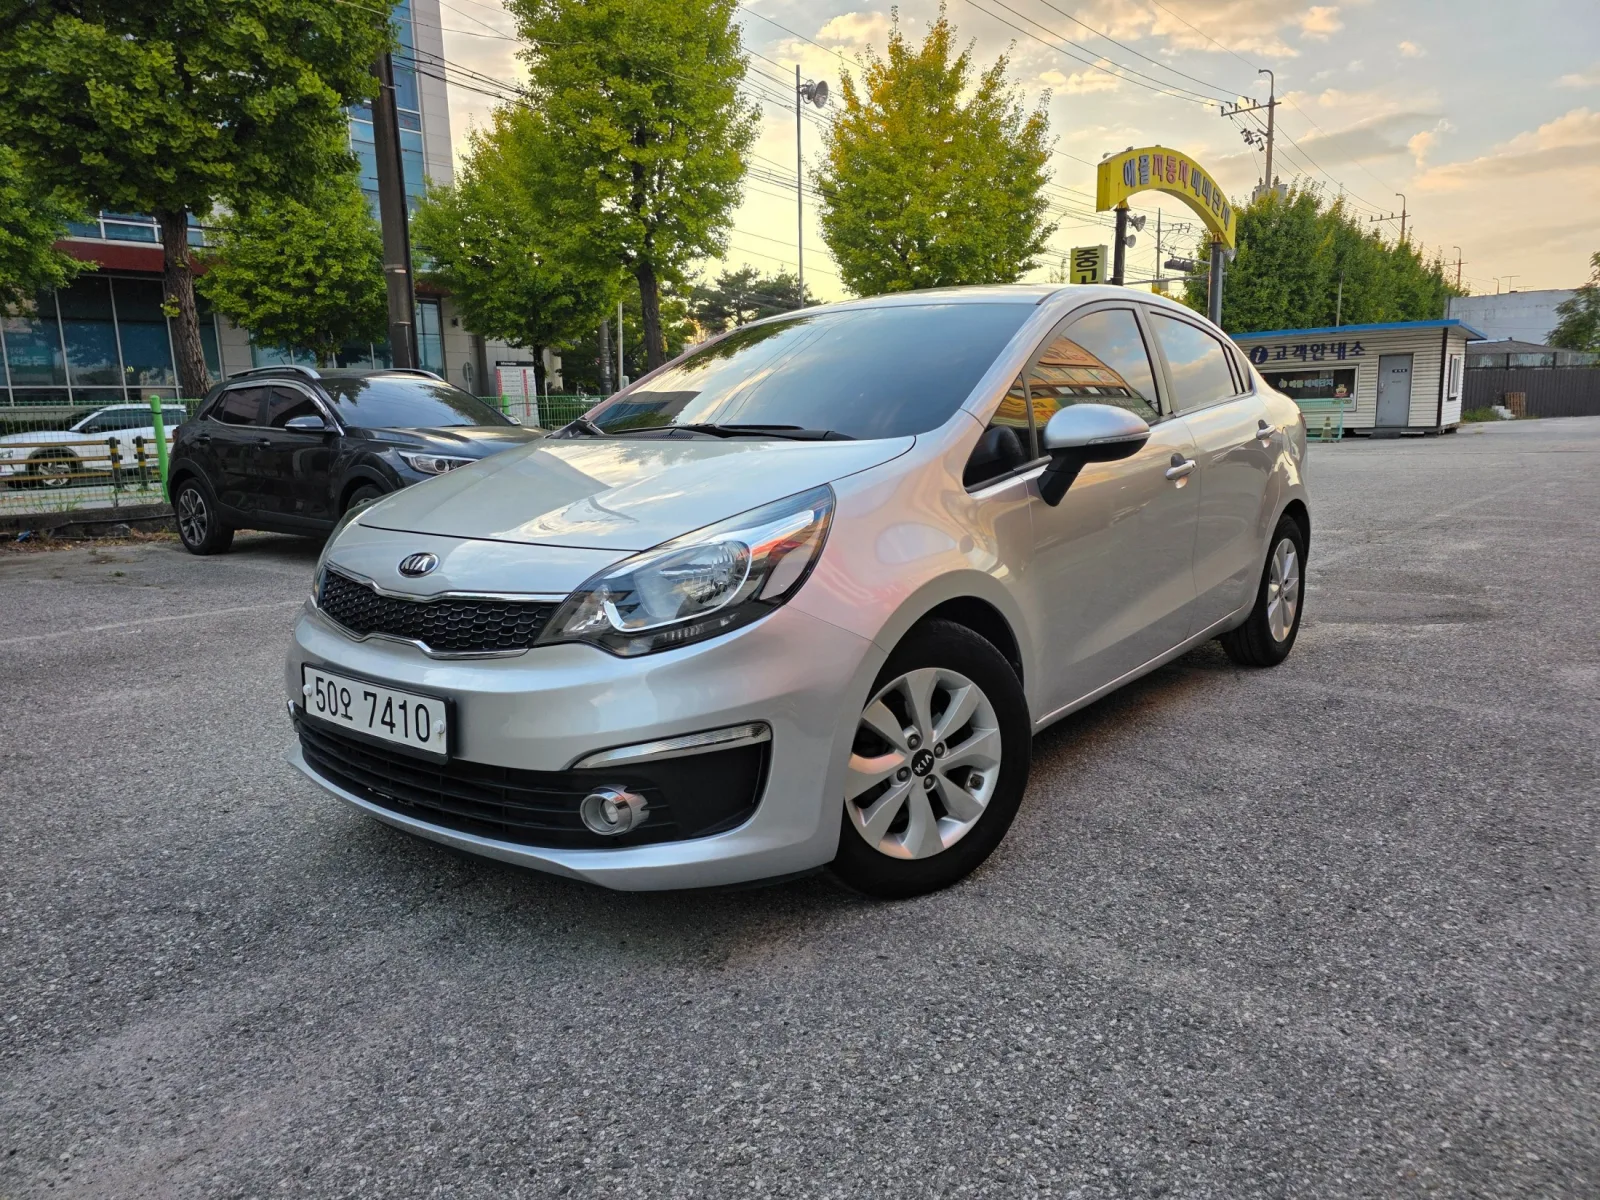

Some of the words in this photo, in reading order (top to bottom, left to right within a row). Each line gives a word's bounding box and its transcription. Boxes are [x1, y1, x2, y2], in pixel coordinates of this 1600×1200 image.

[1272, 341, 1366, 362] 고객안내소
[315, 676, 353, 721] 50오
[363, 690, 430, 743] 7410
[914, 754, 932, 773] KIA
